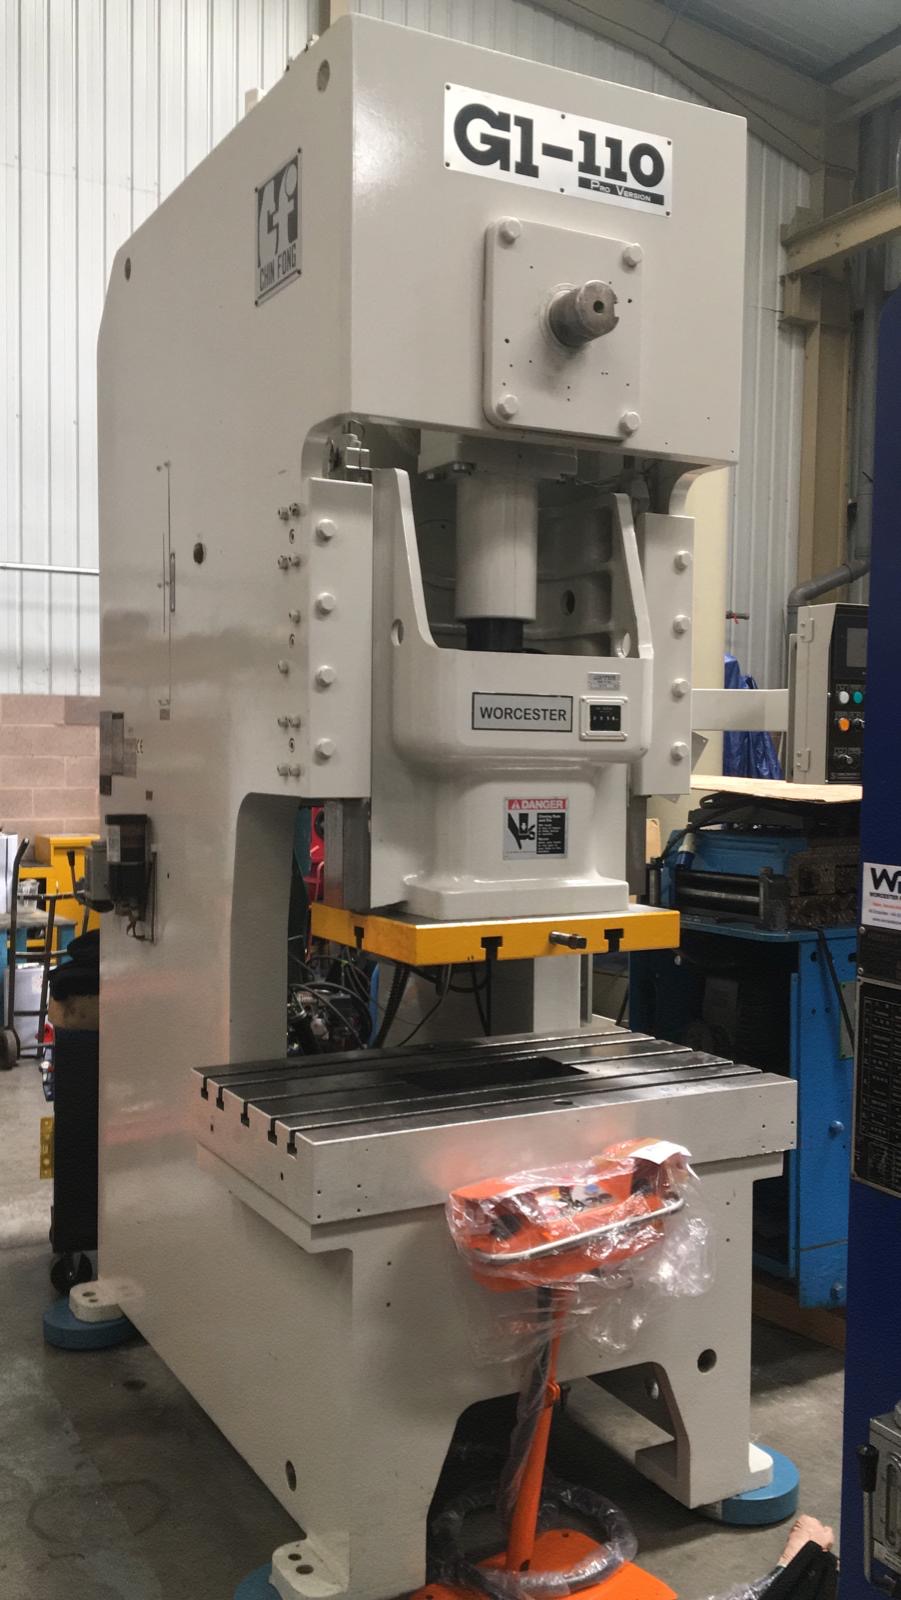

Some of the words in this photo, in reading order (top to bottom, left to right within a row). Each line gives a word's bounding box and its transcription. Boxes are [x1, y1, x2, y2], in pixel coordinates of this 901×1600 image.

[453, 103, 665, 188] G1-110
[260, 258, 275, 292] CHIN
[277, 242, 297, 280] FONG
[479, 706, 567, 722] WORCESTER
[521, 799, 564, 809] DANGER
